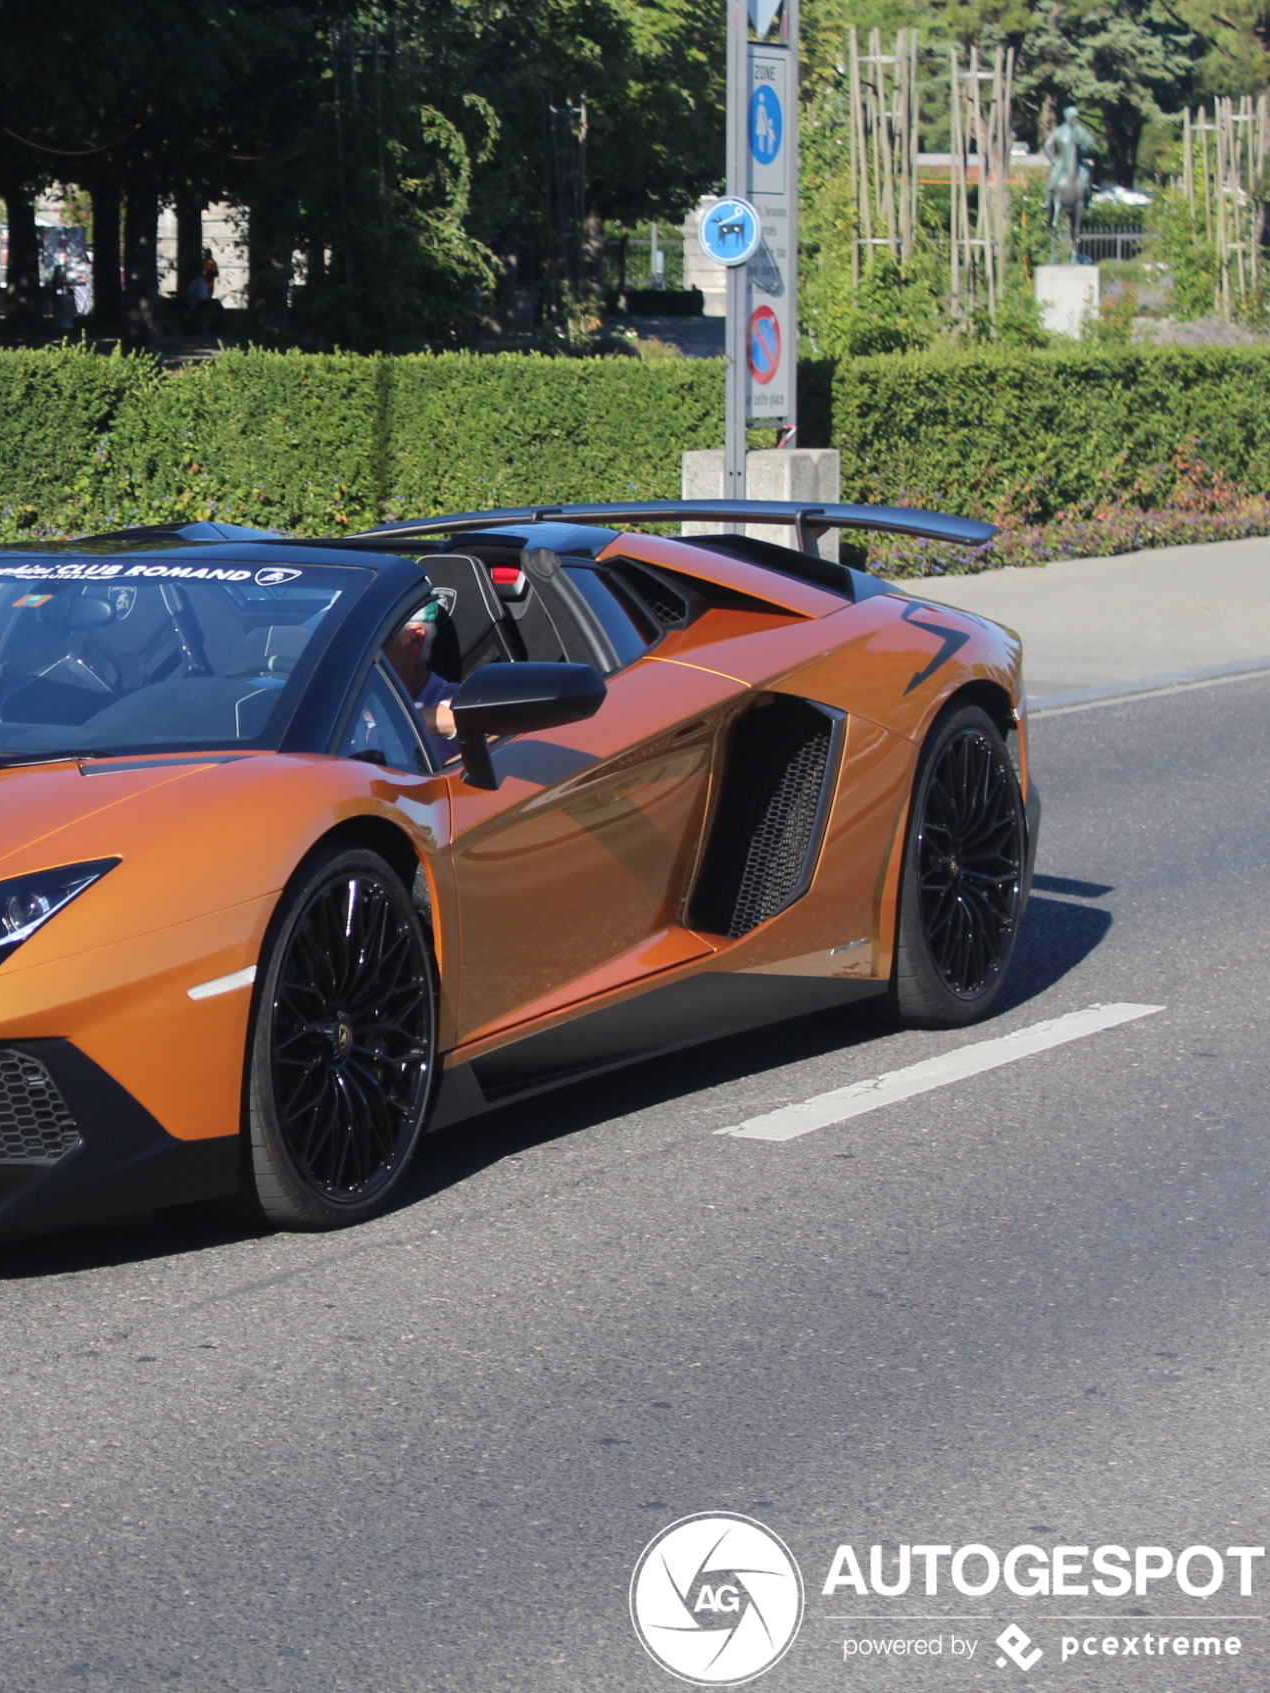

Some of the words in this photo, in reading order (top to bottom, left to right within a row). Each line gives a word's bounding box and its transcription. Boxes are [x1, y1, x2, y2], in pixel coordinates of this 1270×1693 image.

[754, 65, 776, 81] ZONE
[57, 564, 124, 576] CLUB
[123, 565, 252, 581] ROMAND
